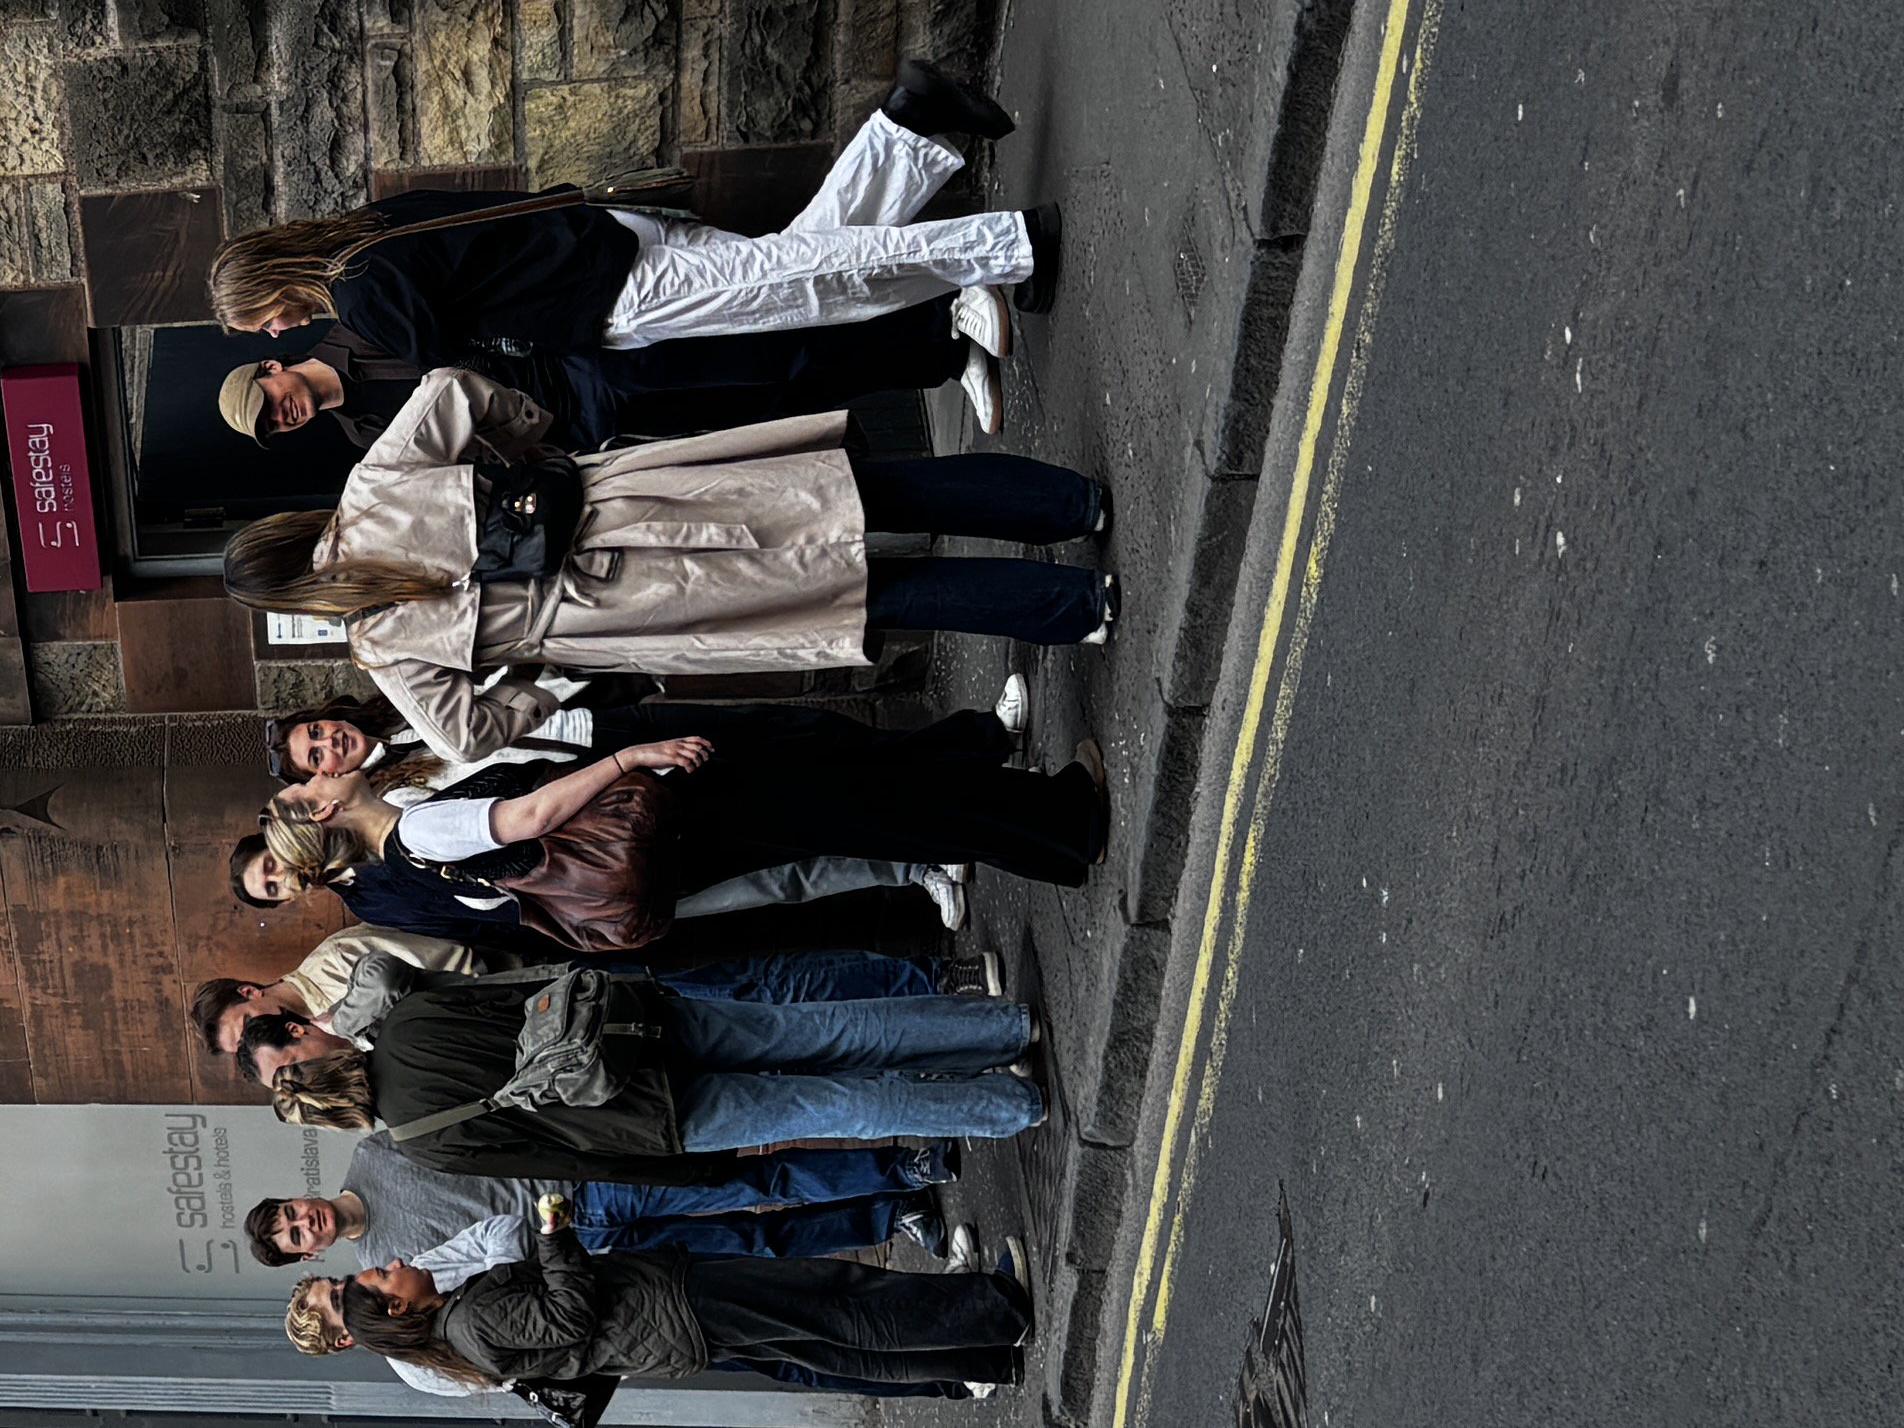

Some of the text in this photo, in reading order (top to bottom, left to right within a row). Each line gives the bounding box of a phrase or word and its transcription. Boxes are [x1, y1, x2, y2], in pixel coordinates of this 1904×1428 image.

[26, 423, 57, 513] safestay
[162, 1113, 207, 1228] safestay
[212, 1127, 236, 1229] hostels & hotels
